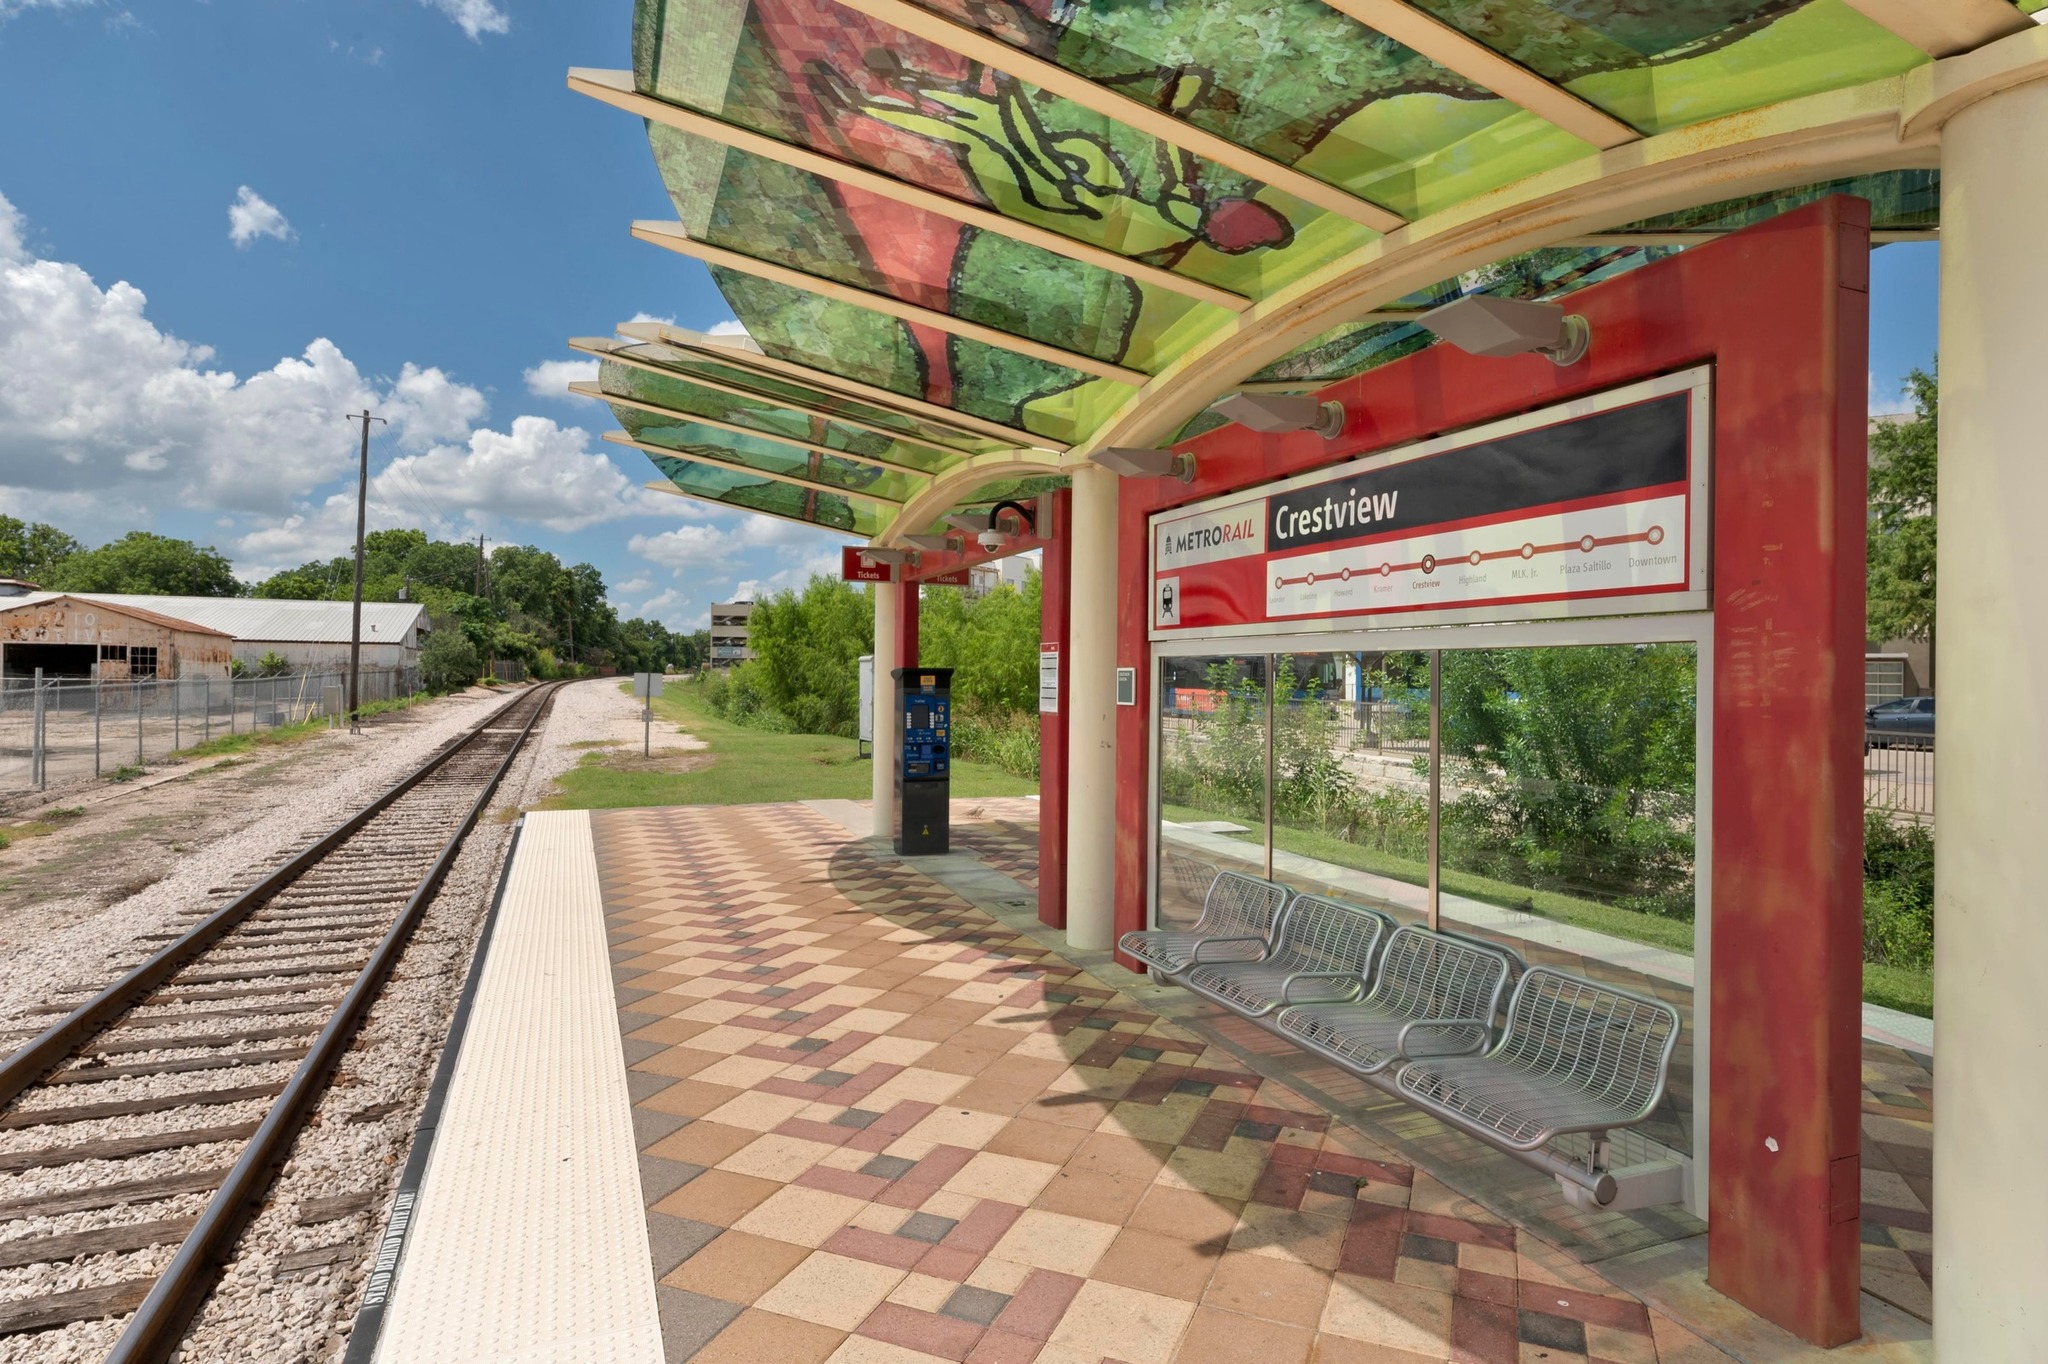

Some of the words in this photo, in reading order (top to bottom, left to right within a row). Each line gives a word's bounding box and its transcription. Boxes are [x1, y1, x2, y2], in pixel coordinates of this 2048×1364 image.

[1276, 488, 1398, 539] Crestview
[1176, 519, 1254, 553] METRORAIL
[1559, 564, 1581, 575] Plaza
[1583, 560, 1612, 572] Saltillo
[1628, 555, 1678, 568] Downtown
[857, 571, 880, 580] Tickets
[1458, 573, 1487, 586] Highland
[1530, 569, 1539, 579] Jr.
[1373, 585, 1393, 593] Kramer
[1412, 578, 1440, 590] Crestview
[1333, 588, 1354, 597] Howard
[394, 1192, 415, 1210] LINE
[385, 1210, 410, 1238] WHITE
[374, 1237, 402, 1272] BEHIND
[363, 1272, 391, 1305] STAND
